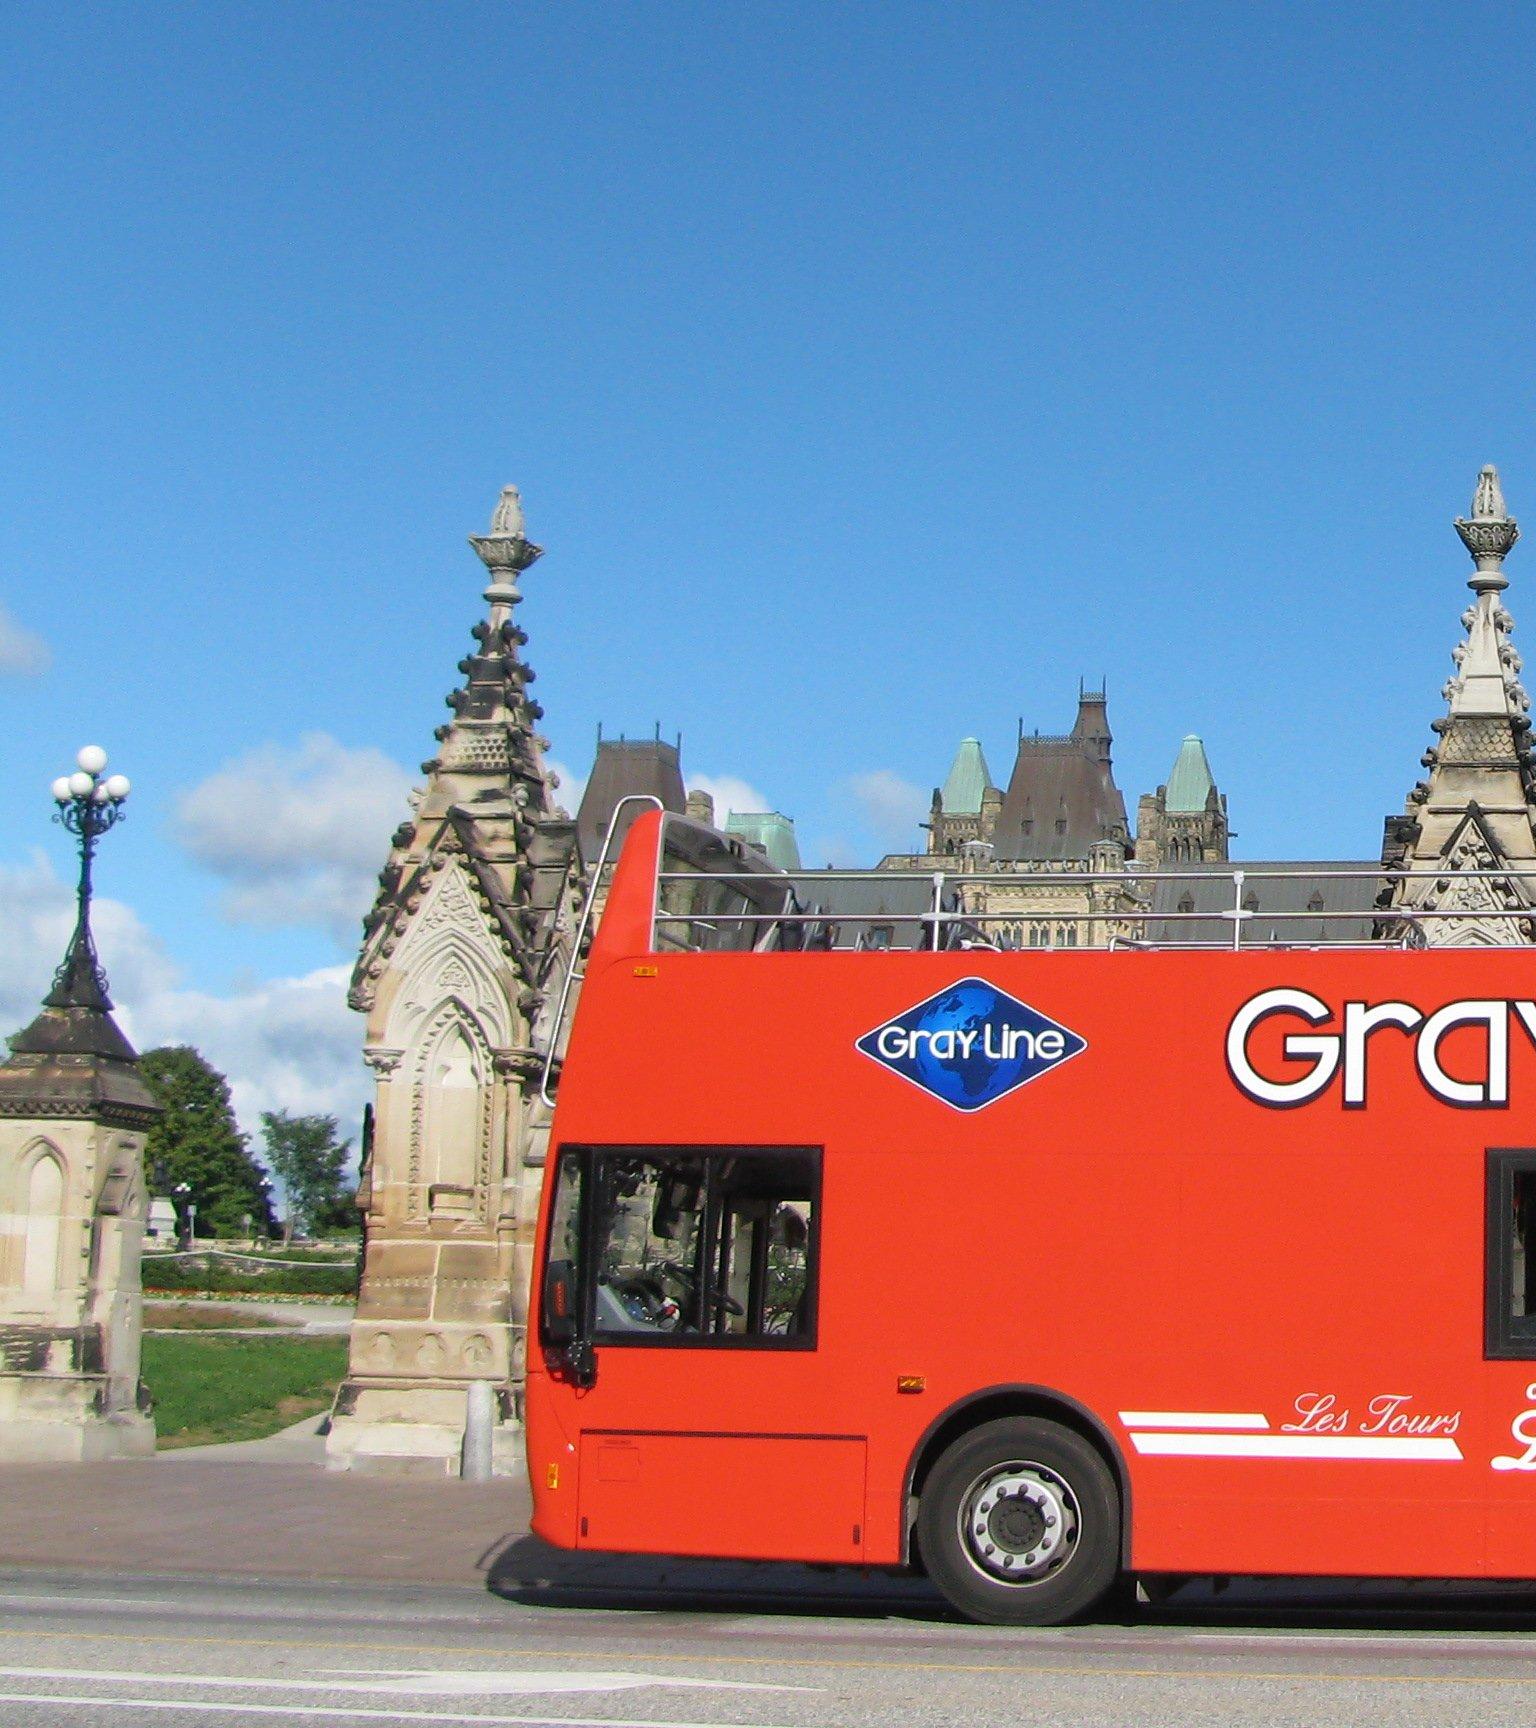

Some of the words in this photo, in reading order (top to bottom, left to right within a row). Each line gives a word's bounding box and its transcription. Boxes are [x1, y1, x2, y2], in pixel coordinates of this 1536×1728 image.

[877, 1025, 978, 1060] Gray
[984, 1023, 1066, 1060] Line
[1280, 1392, 1350, 1433] Les
[1359, 1394, 1462, 1434] Tours
